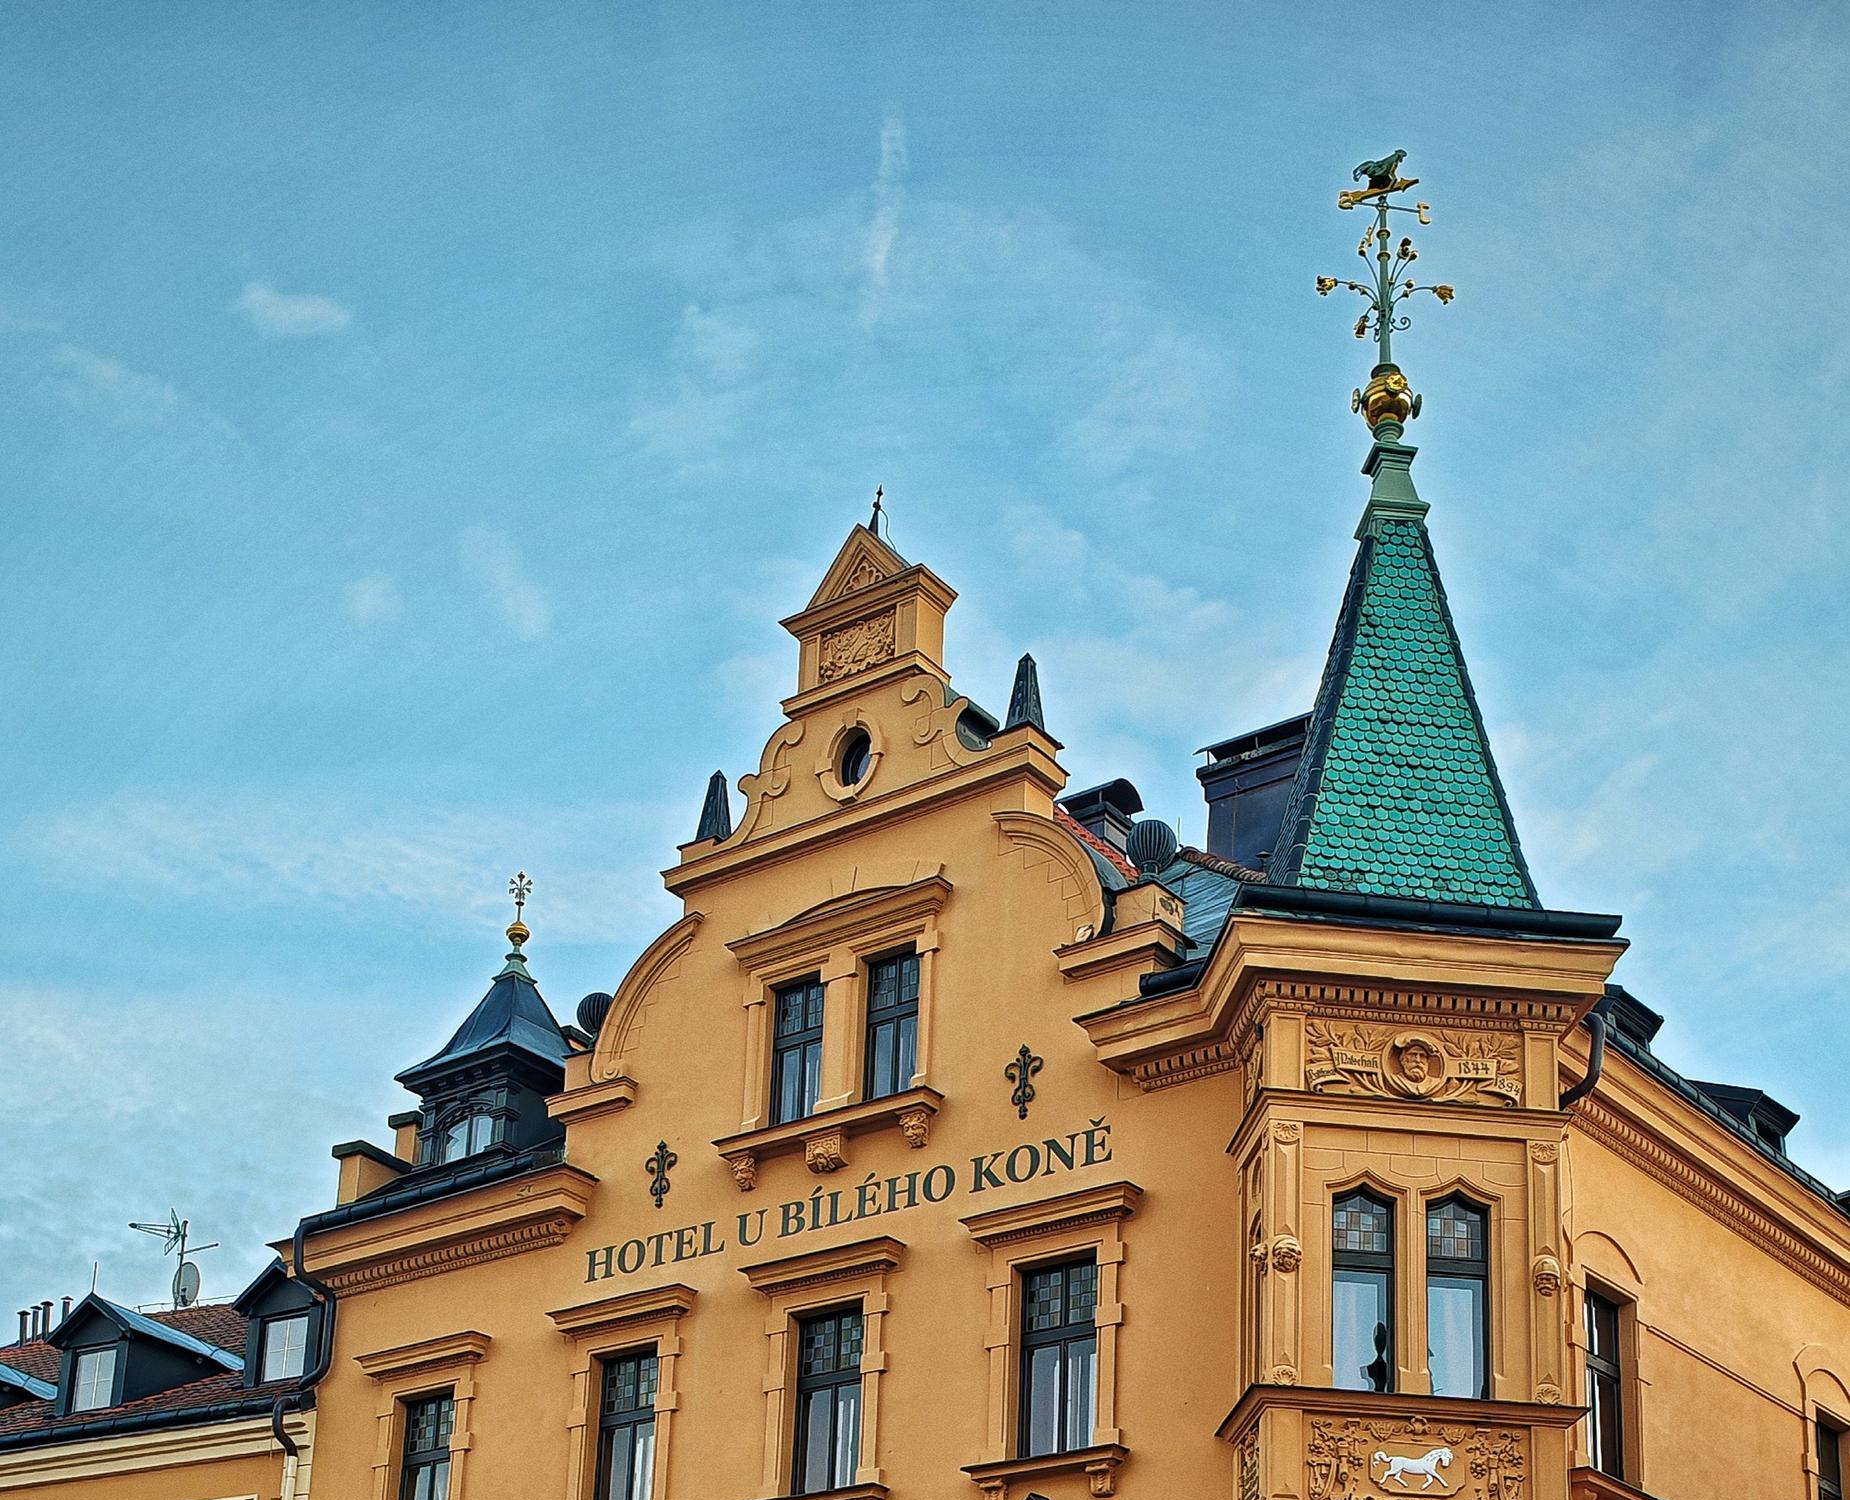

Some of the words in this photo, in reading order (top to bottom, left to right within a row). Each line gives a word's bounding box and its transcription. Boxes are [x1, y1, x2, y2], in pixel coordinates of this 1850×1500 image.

[1457, 1061, 1491, 1076] 1844
[1494, 1077, 1522, 1097] 1894
[582, 1220, 726, 1284] HOTEL
[735, 1209, 769, 1248] U
[776, 1164, 957, 1239] BÍLÉHO
[968, 1115, 1115, 1195] KONĚ
